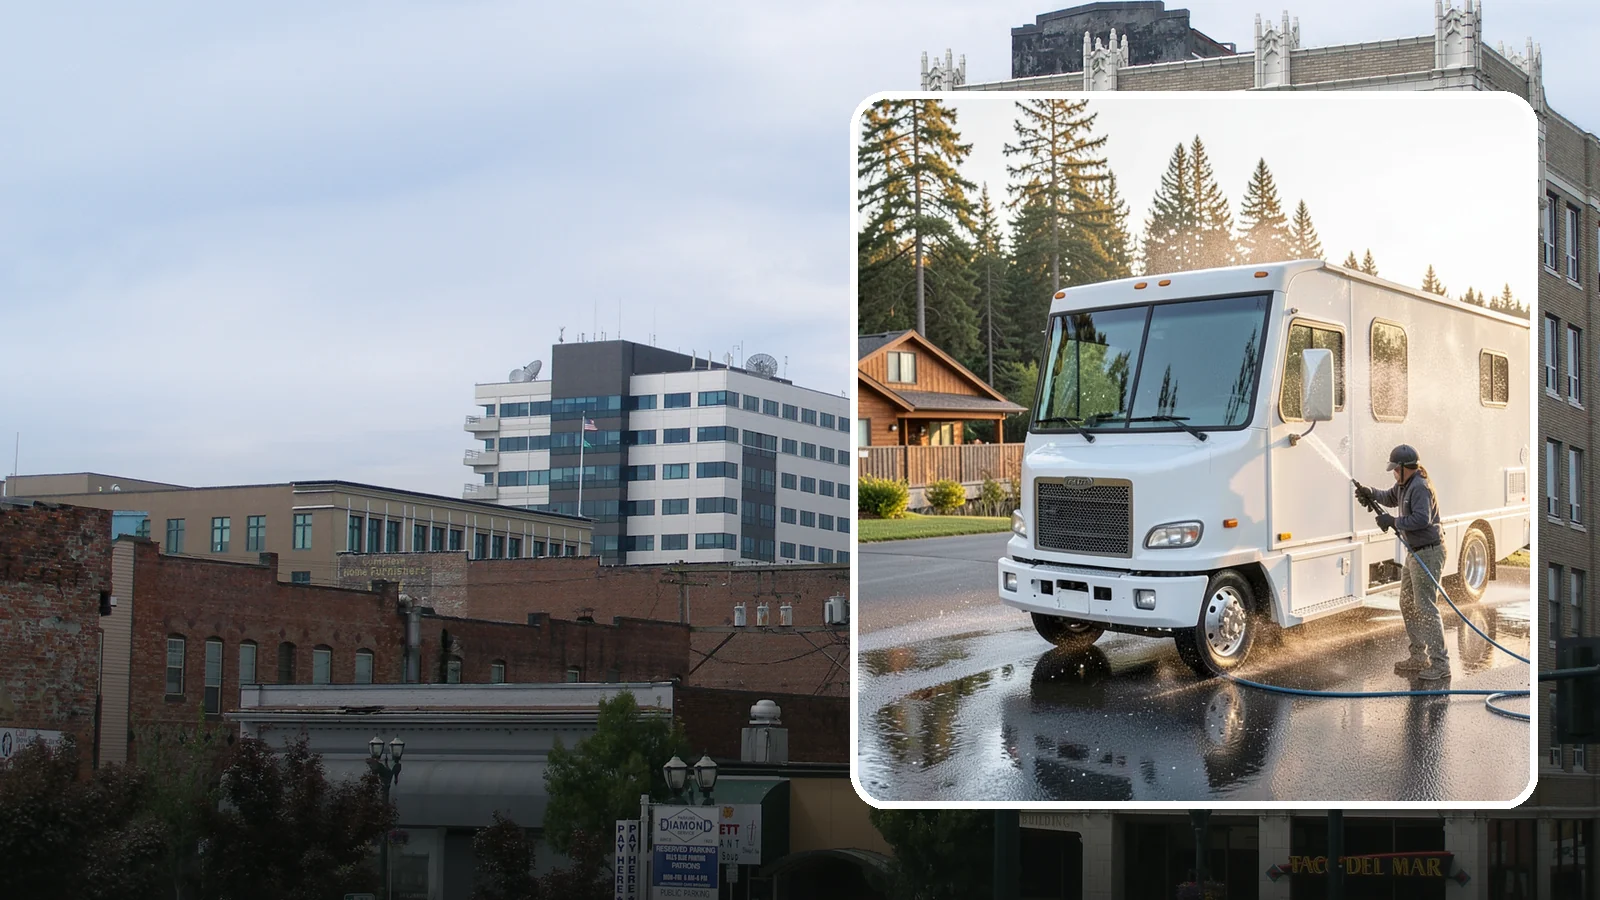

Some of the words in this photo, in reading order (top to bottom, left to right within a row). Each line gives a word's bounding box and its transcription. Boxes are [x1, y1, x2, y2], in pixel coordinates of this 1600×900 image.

[343, 568, 367, 577] Home
[370, 566, 427, 576] Furnishers
[660, 818, 713, 833] DIAMOND
[1022, 815, 1069, 828] BUILDING
[617, 825, 625, 852] PAY
[628, 824, 637, 852] PAY
[656, 845, 688, 853] RESERVED
[689, 846, 716, 854] PARKING
[721, 851, 739, 861] Soup
[671, 862, 701, 870] PATRONS
[1345, 857, 1385, 876] DEL
[1392, 857, 1443, 877] MAR
[616, 856, 625, 894] HERE
[627, 856, 636, 893] HERE
[660, 888, 682, 897] PUBLIC
[683, 889, 710, 898] PARKING
